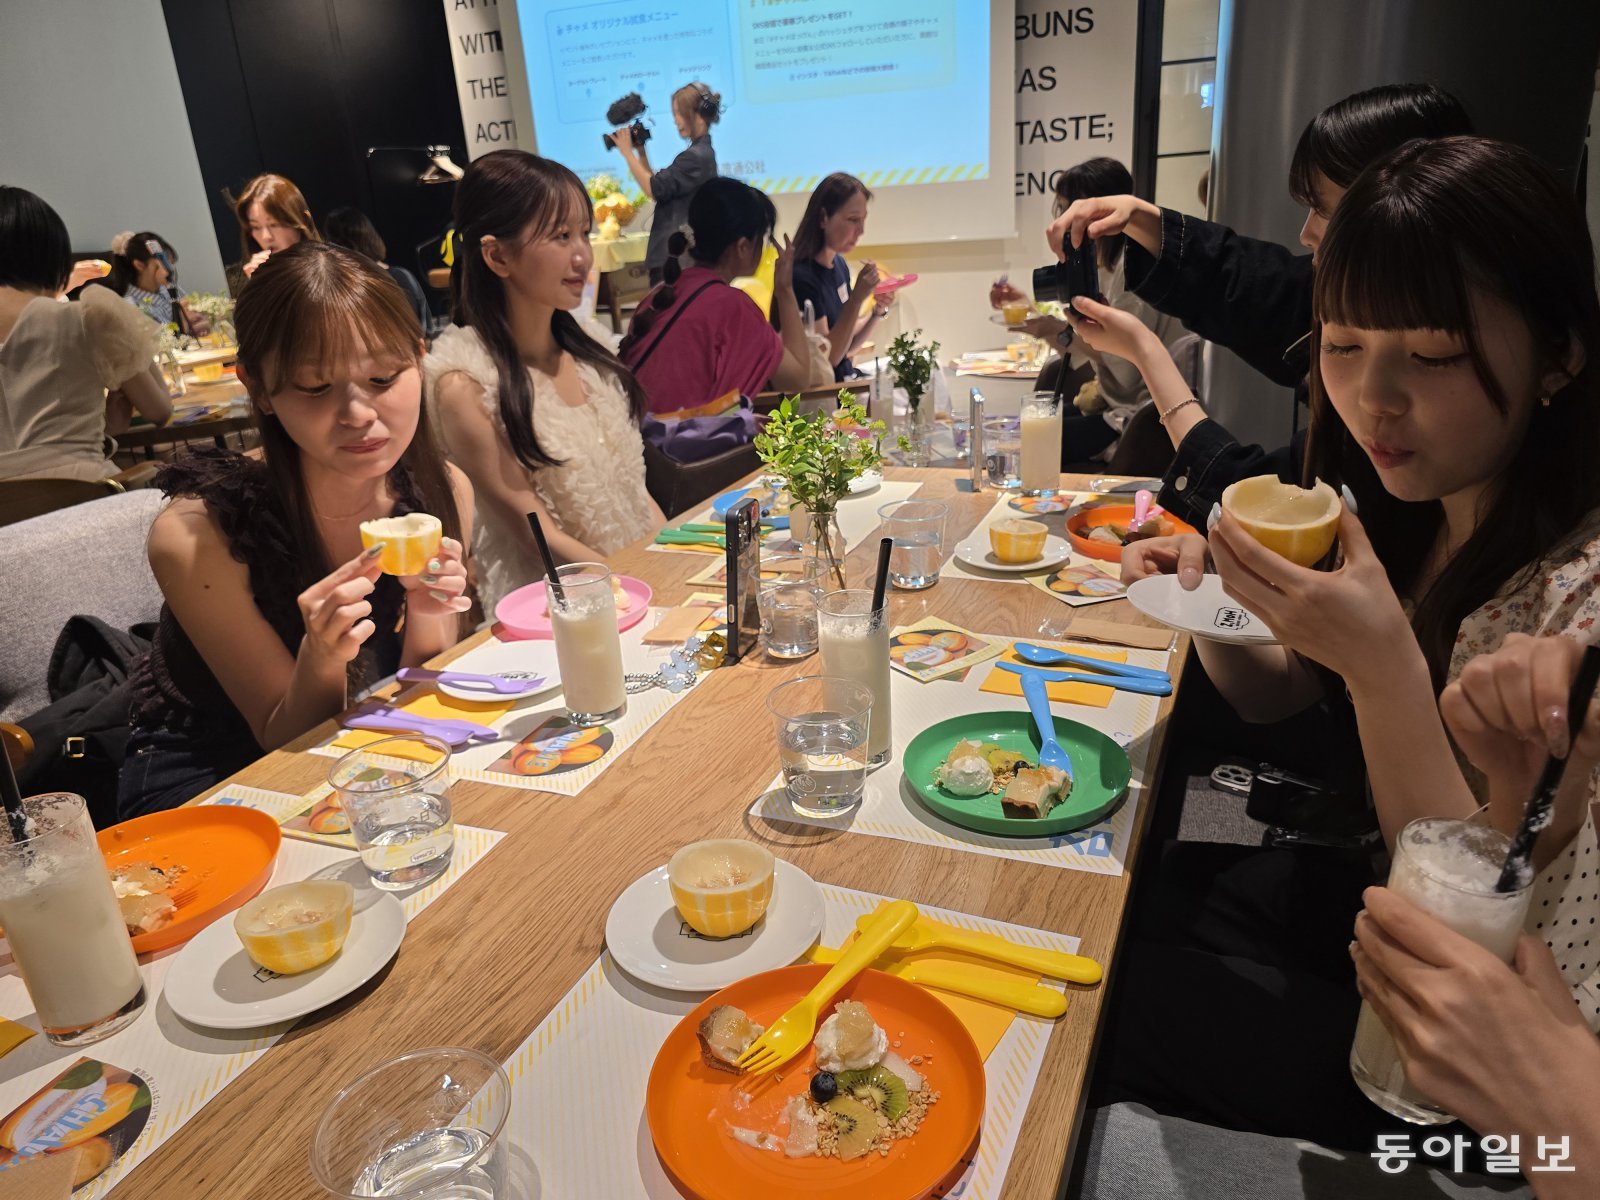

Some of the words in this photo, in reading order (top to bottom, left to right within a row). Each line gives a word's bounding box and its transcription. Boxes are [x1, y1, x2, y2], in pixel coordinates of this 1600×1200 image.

[1015, 7, 1094, 40] BUNS
[467, 76, 507, 100] THE
[1018, 66, 1057, 93] AS
[1015, 114, 1114, 146] TASTE;
